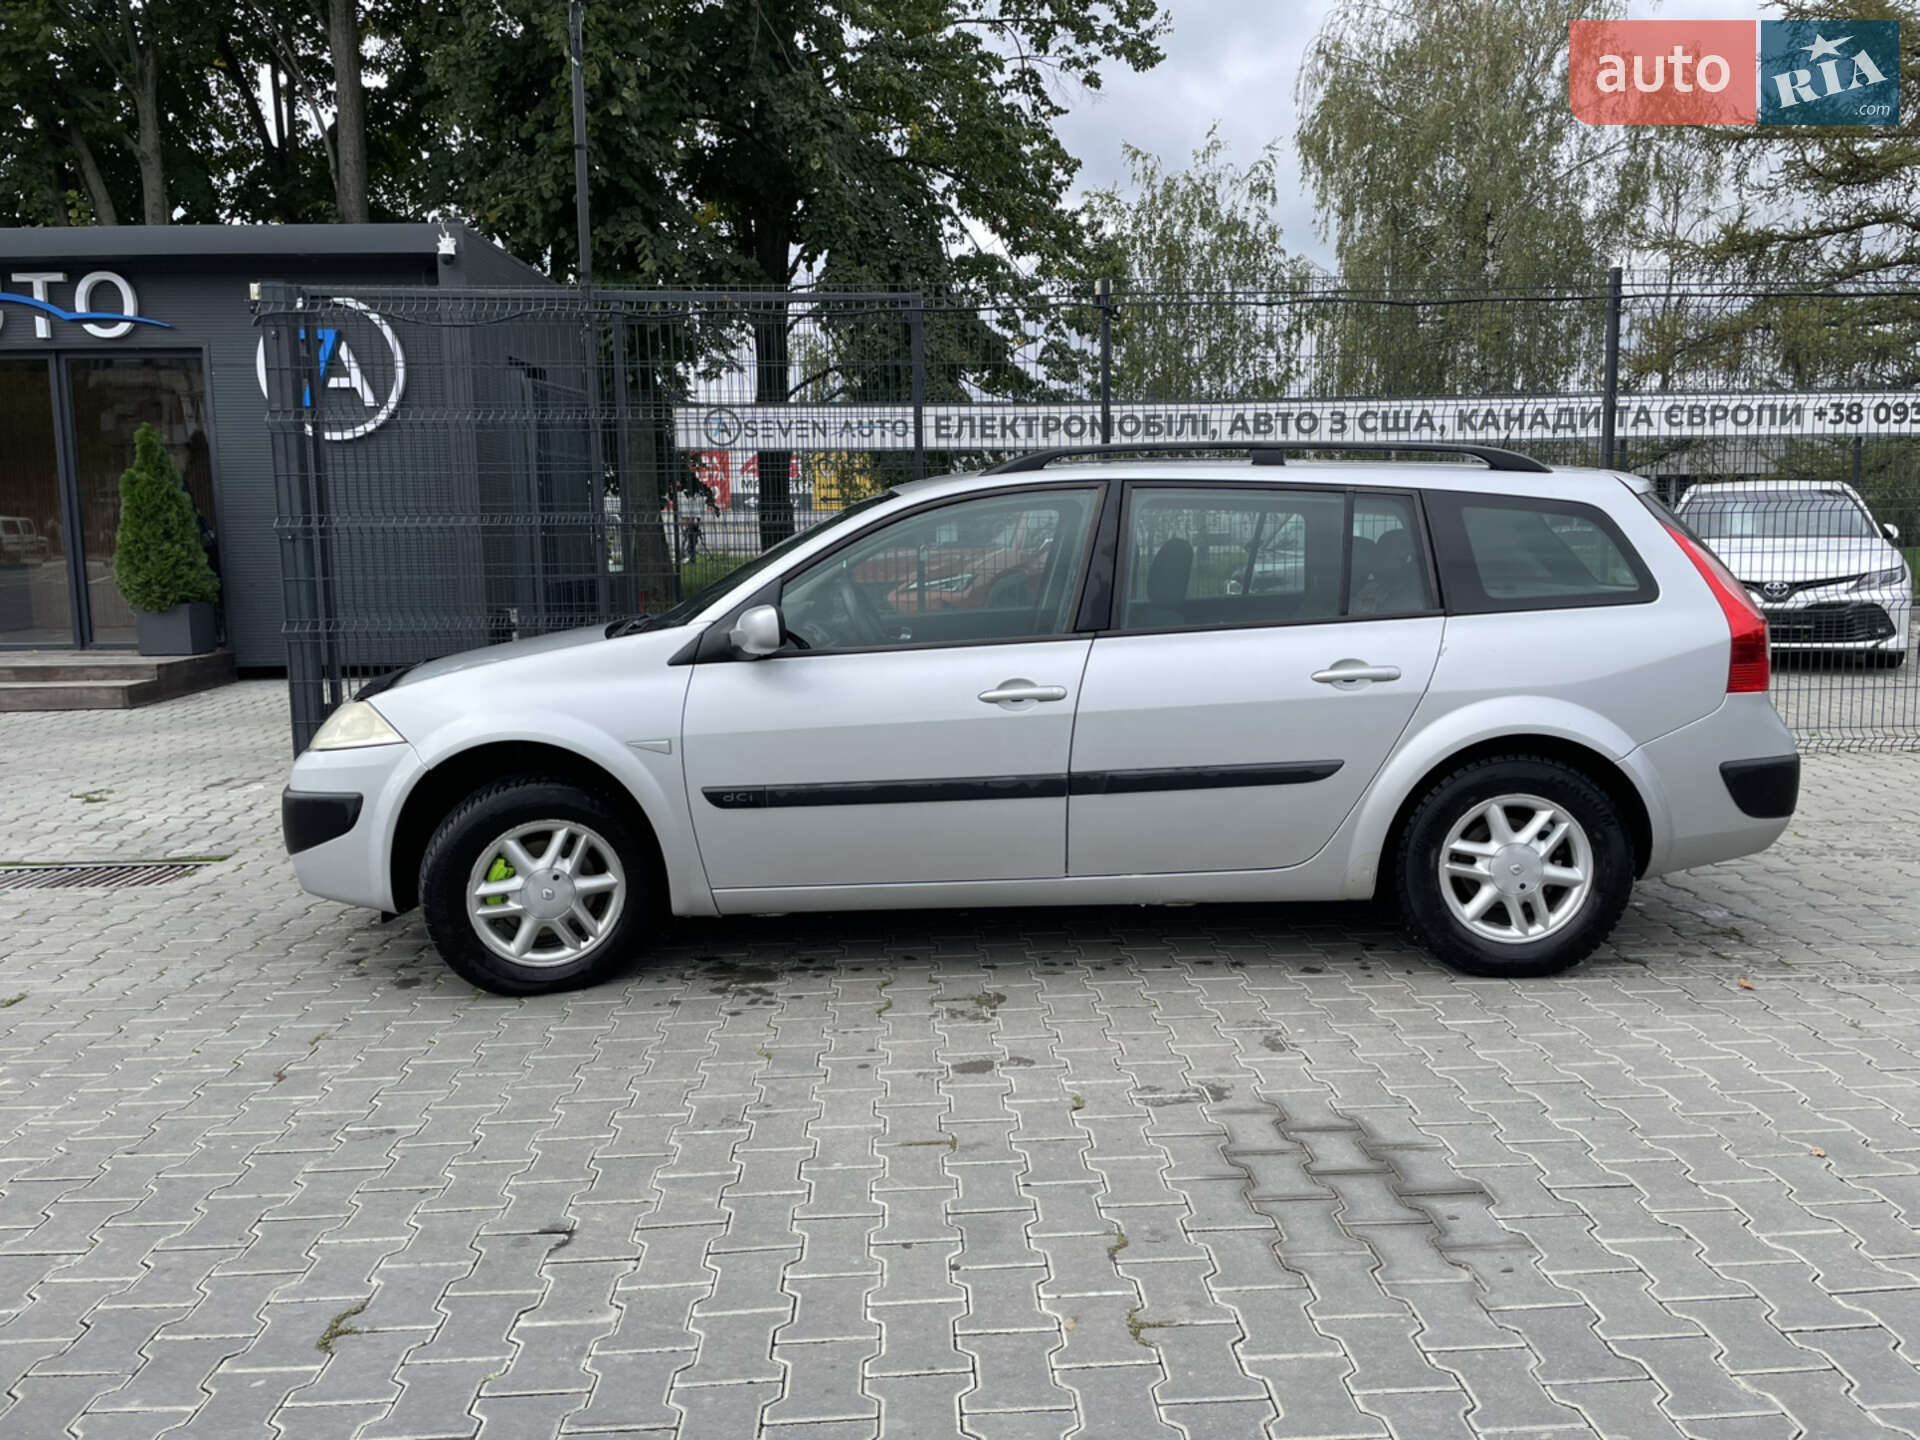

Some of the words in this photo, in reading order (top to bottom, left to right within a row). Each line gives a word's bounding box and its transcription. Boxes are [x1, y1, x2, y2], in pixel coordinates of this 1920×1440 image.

[0, 270, 138, 339] TO
[744, 419, 827, 438] SEVEN
[838, 419, 909, 438] AUTO
[1228, 411, 1320, 434] АВТО
[1358, 408, 1446, 436] США,
[1456, 406, 1600, 433] КАНАДИ
[1615, 404, 1653, 428] ТА
[1664, 403, 1801, 427] ЄВРОПИ
[1813, 402, 1864, 425] +38
[1873, 402, 1920, 424] 093
